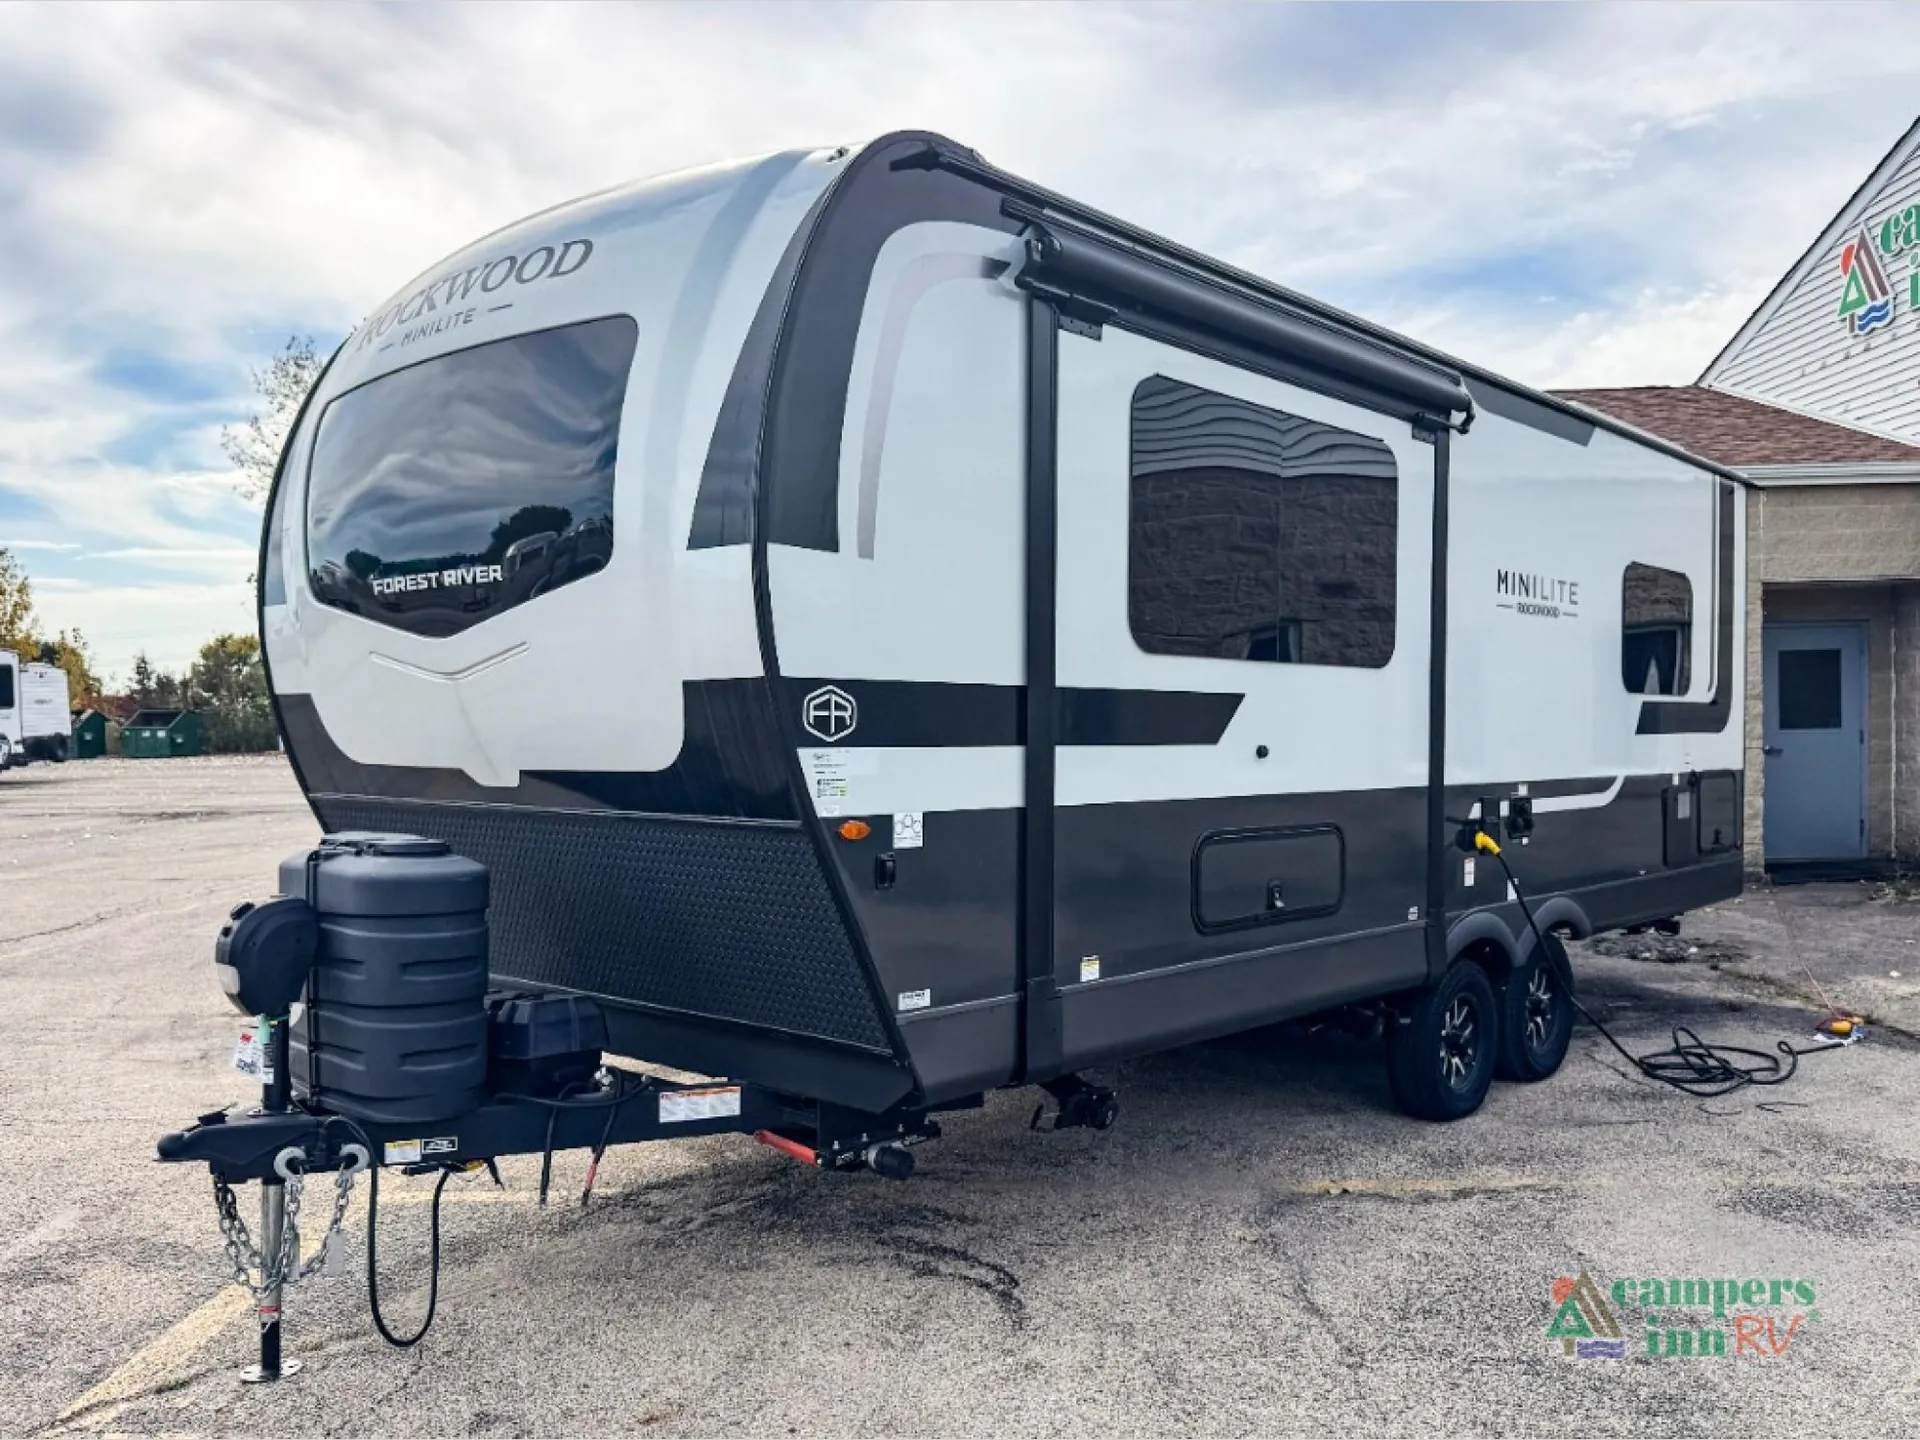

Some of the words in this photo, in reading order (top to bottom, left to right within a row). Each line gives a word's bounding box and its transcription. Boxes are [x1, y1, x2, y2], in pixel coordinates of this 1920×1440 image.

[356, 238, 594, 352] ROCKWOOD
[401, 306, 477, 346] MINILITE
[372, 572, 440, 596] FOREST
[442, 564, 503, 587] RIVER
[1496, 568, 1579, 606] MINILITE
